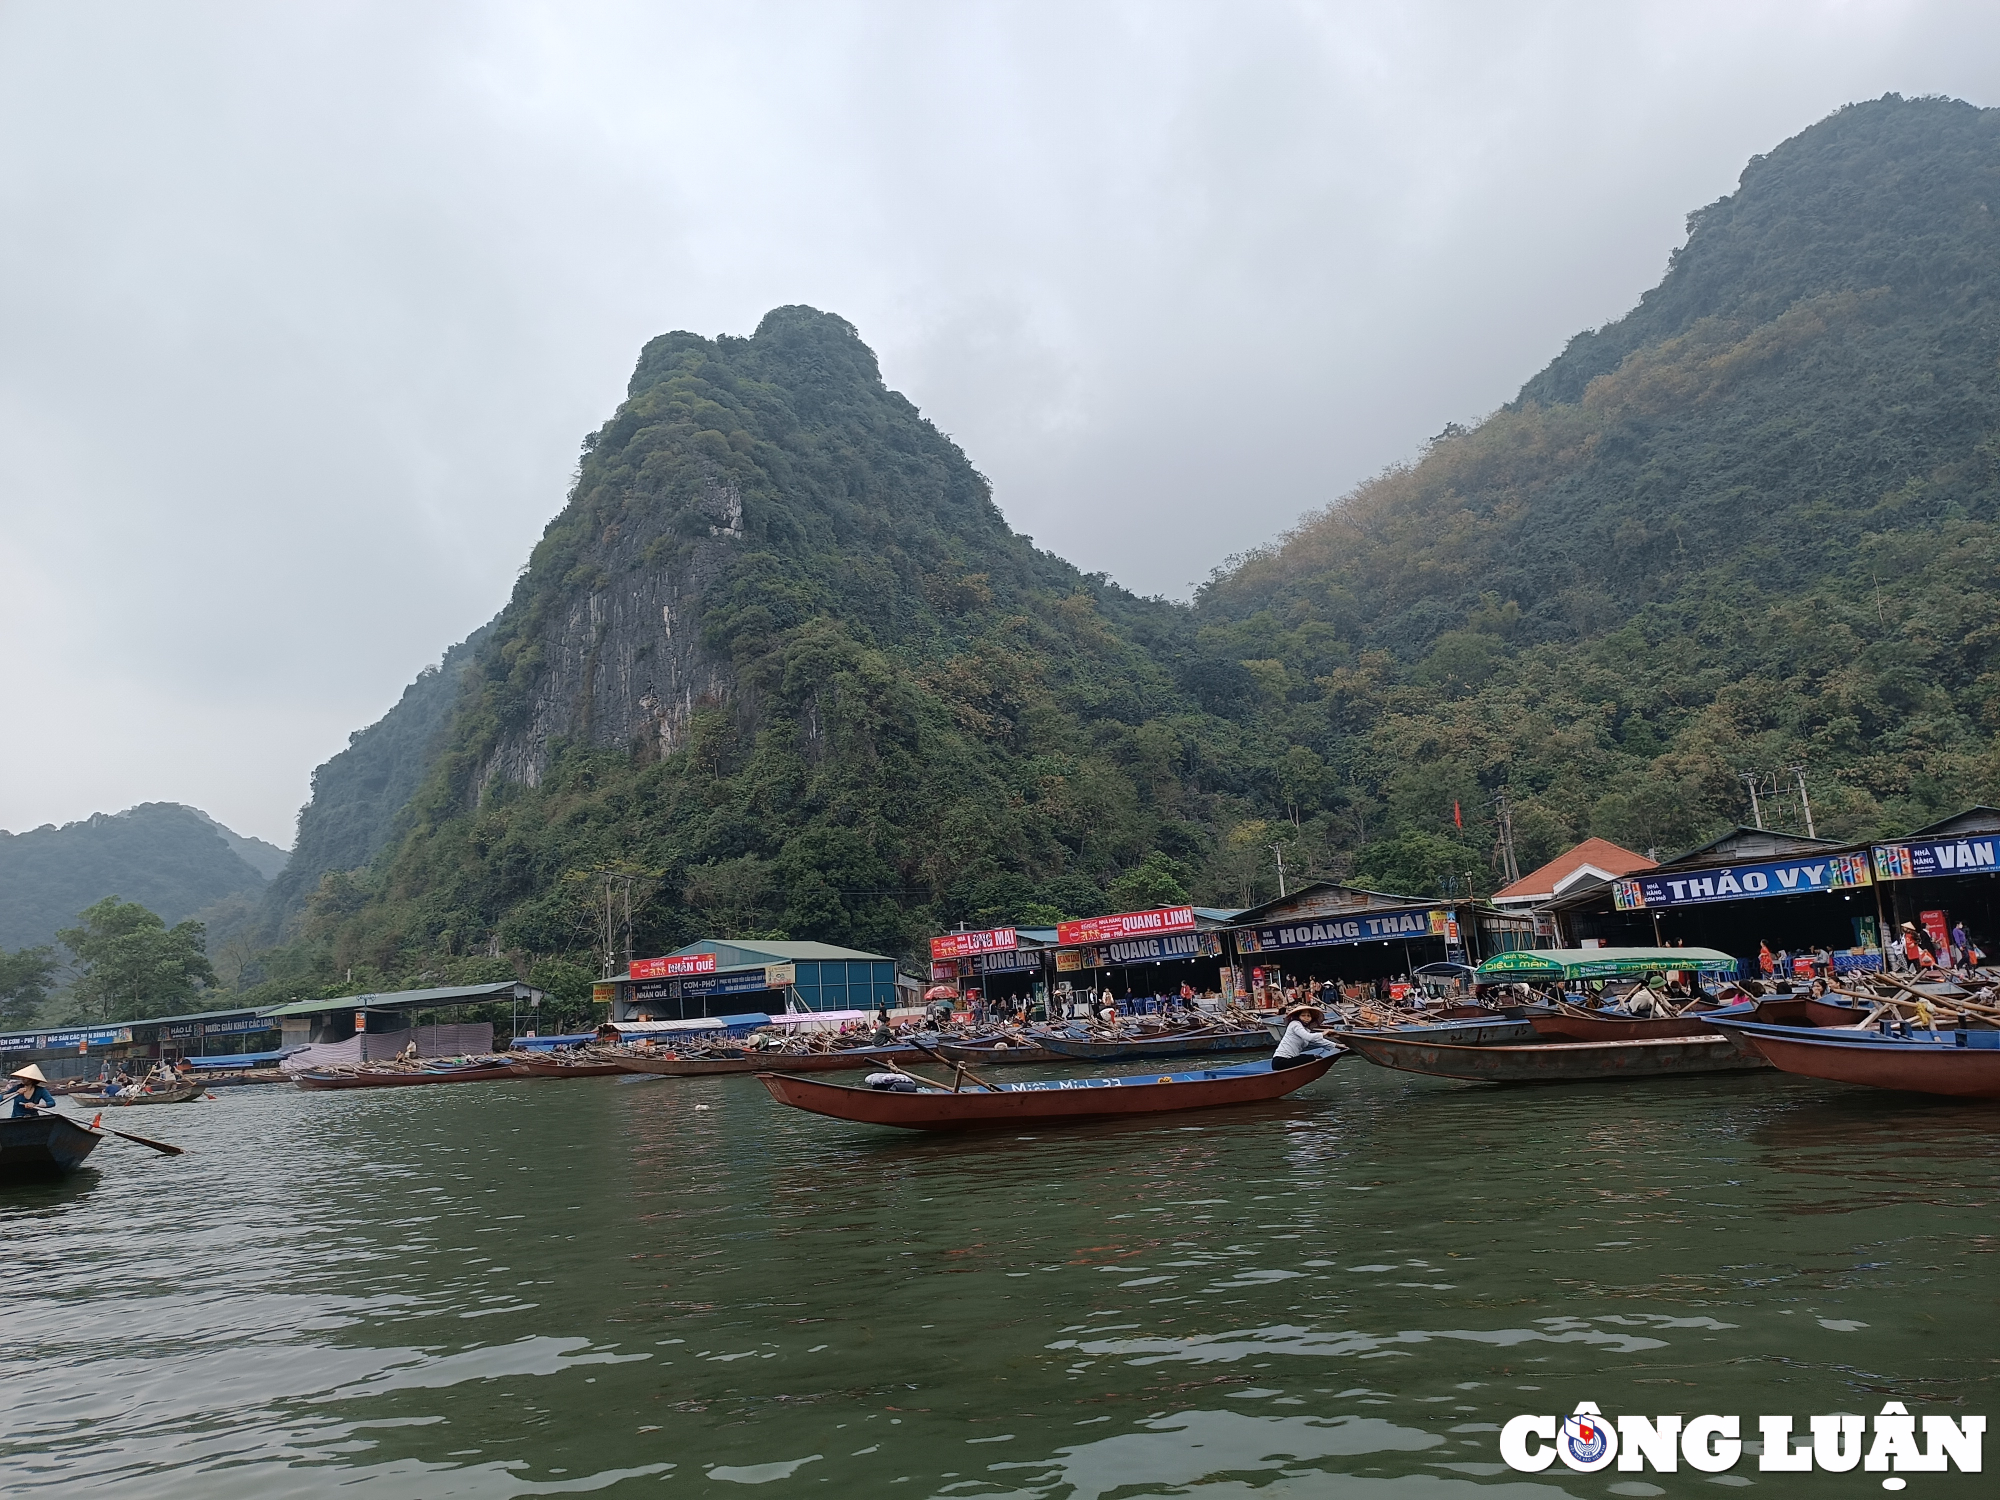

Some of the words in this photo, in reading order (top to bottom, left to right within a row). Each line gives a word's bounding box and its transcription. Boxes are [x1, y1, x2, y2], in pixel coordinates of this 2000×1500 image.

[1913, 857, 1934, 865] HÀNG
[1914, 848, 1930, 856] NHÀ
[1934, 840, 1995, 869] VĂN
[1667, 869, 1768, 899] THẢO
[1774, 864, 1826, 888] VY
[1122, 913, 1160, 931] QUANG
[1164, 910, 1192, 925] LINH
[1280, 922, 1359, 944] HOÀNG
[1366, 914, 1425, 934] THÁI
[968, 933, 993, 949] LONG
[995, 931, 1014, 945] MAI
[1110, 939, 1159, 962] QUANG
[1164, 935, 1199, 954] LINH
[668, 960, 693, 973] NHÀN
[696, 958, 714, 972] QUÊ
[983, 953, 1014, 970] LONG
[1016, 952, 1040, 966] MAI
[637, 990, 653, 998] NHÀN
[249, 1019, 260, 1028] CÁC
